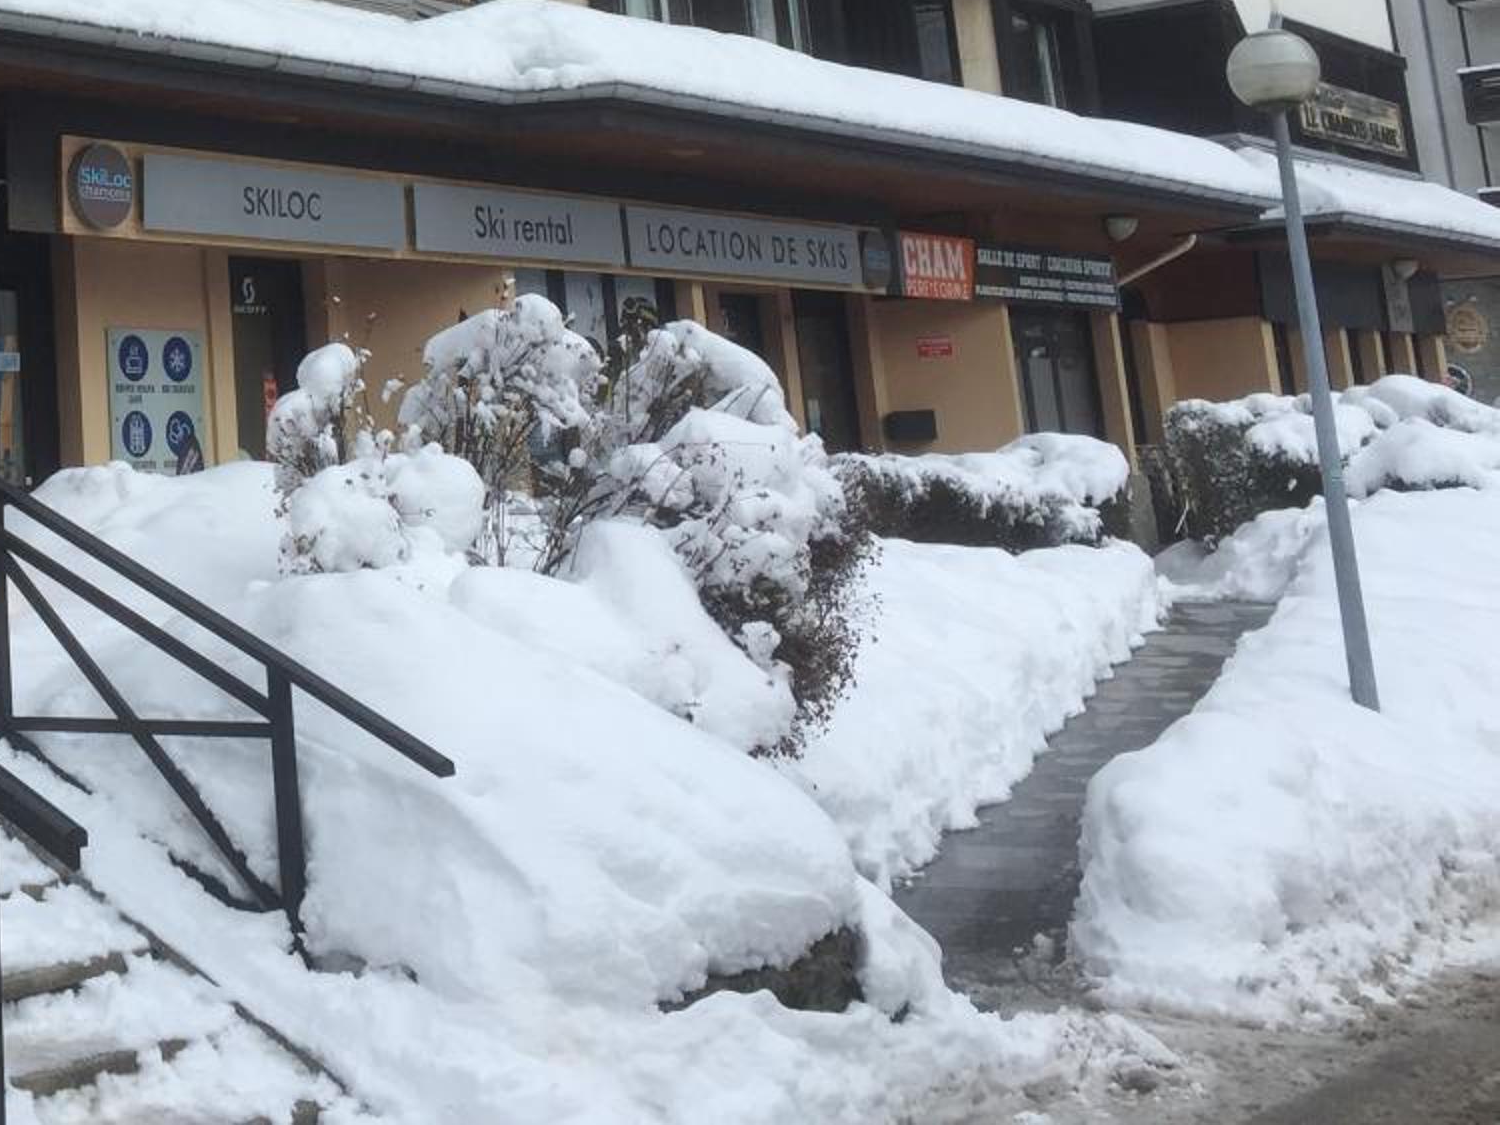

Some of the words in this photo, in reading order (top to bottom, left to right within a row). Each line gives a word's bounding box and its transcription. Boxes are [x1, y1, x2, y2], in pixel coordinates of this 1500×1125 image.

[243, 186, 322, 221] SKILOC
[475, 205, 506, 239] Ski
[514, 213, 573, 245] rental
[647, 223, 762, 262] LOCATION
[772, 236, 798, 265] DE
[806, 238, 848, 270] SKIS
[902, 236, 966, 280] CHAM
